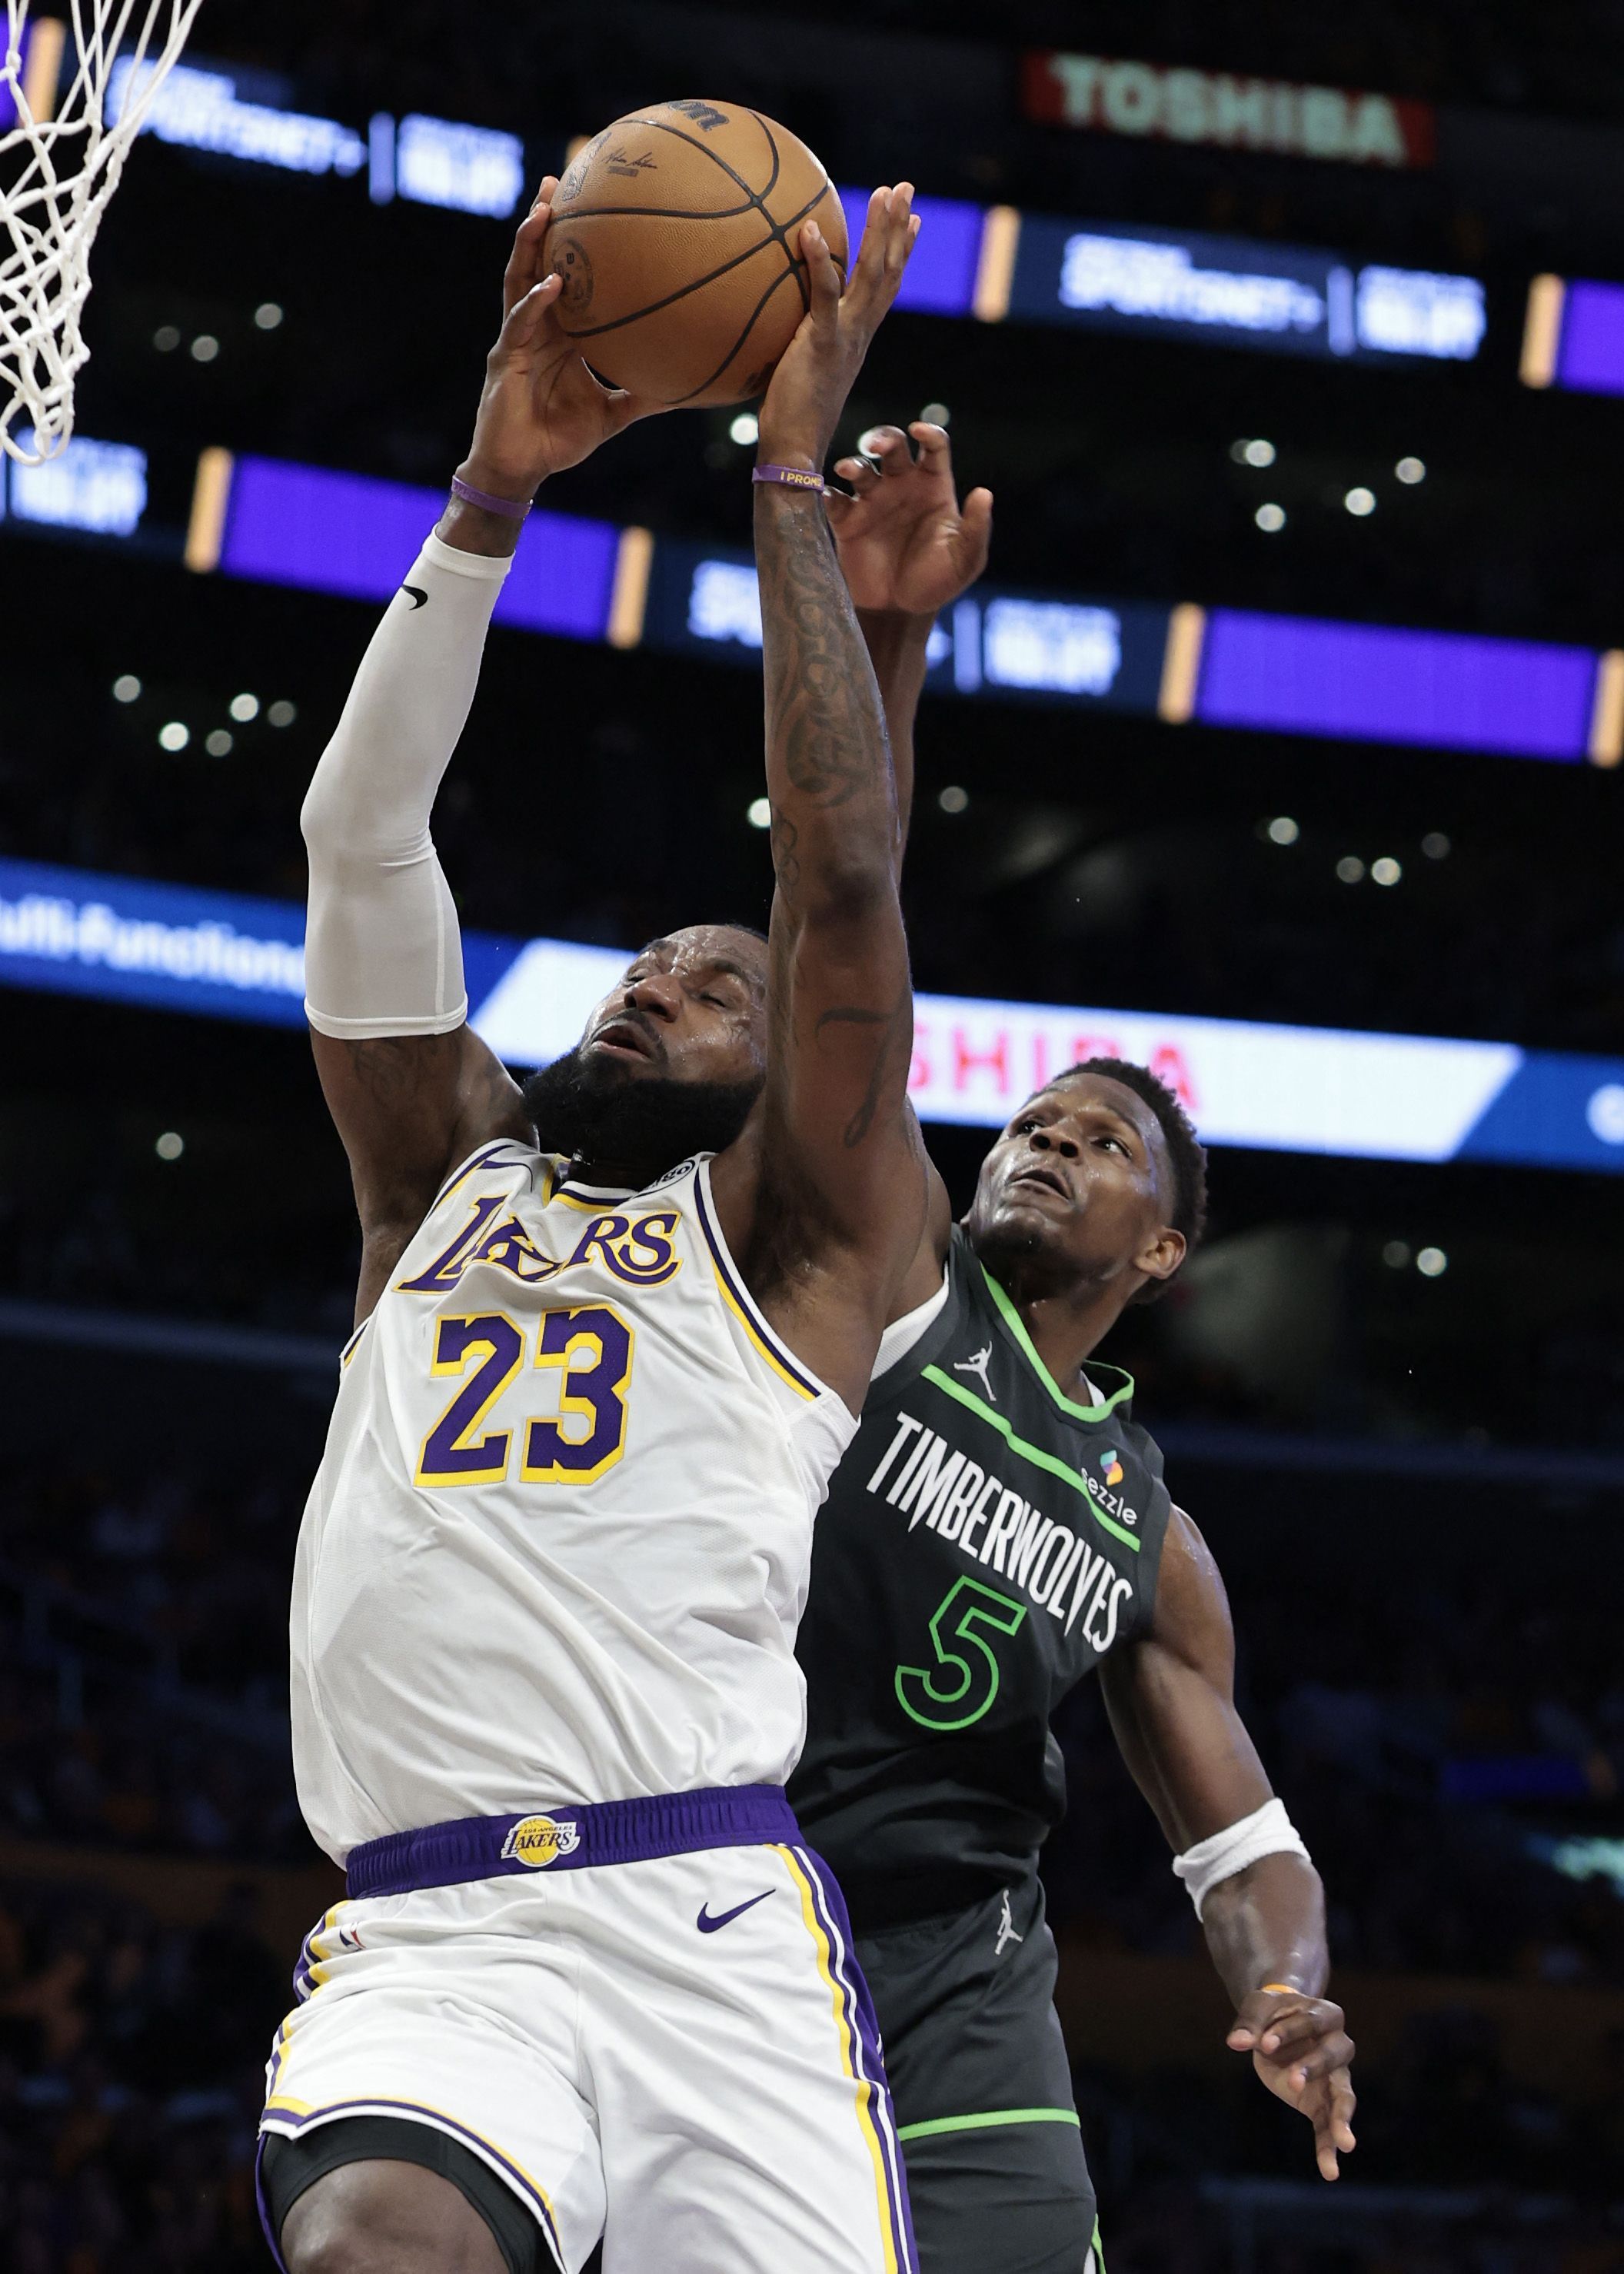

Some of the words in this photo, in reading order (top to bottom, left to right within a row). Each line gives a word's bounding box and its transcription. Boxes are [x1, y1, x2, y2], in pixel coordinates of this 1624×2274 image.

[1051, 52, 1406, 167] TOSHIBA
[780, 471, 784, 481] I
[787, 473, 822, 487] PROM
[391, 1193, 684, 1295] LRS
[414, 1303, 635, 1488] 23
[866, 1410, 1133, 1653] TIMBERWOLVES
[1080, 1467, 1137, 1526] sezzle
[894, 1574, 1028, 1731] 5
[502, 1830, 577, 1855] LAKERS
